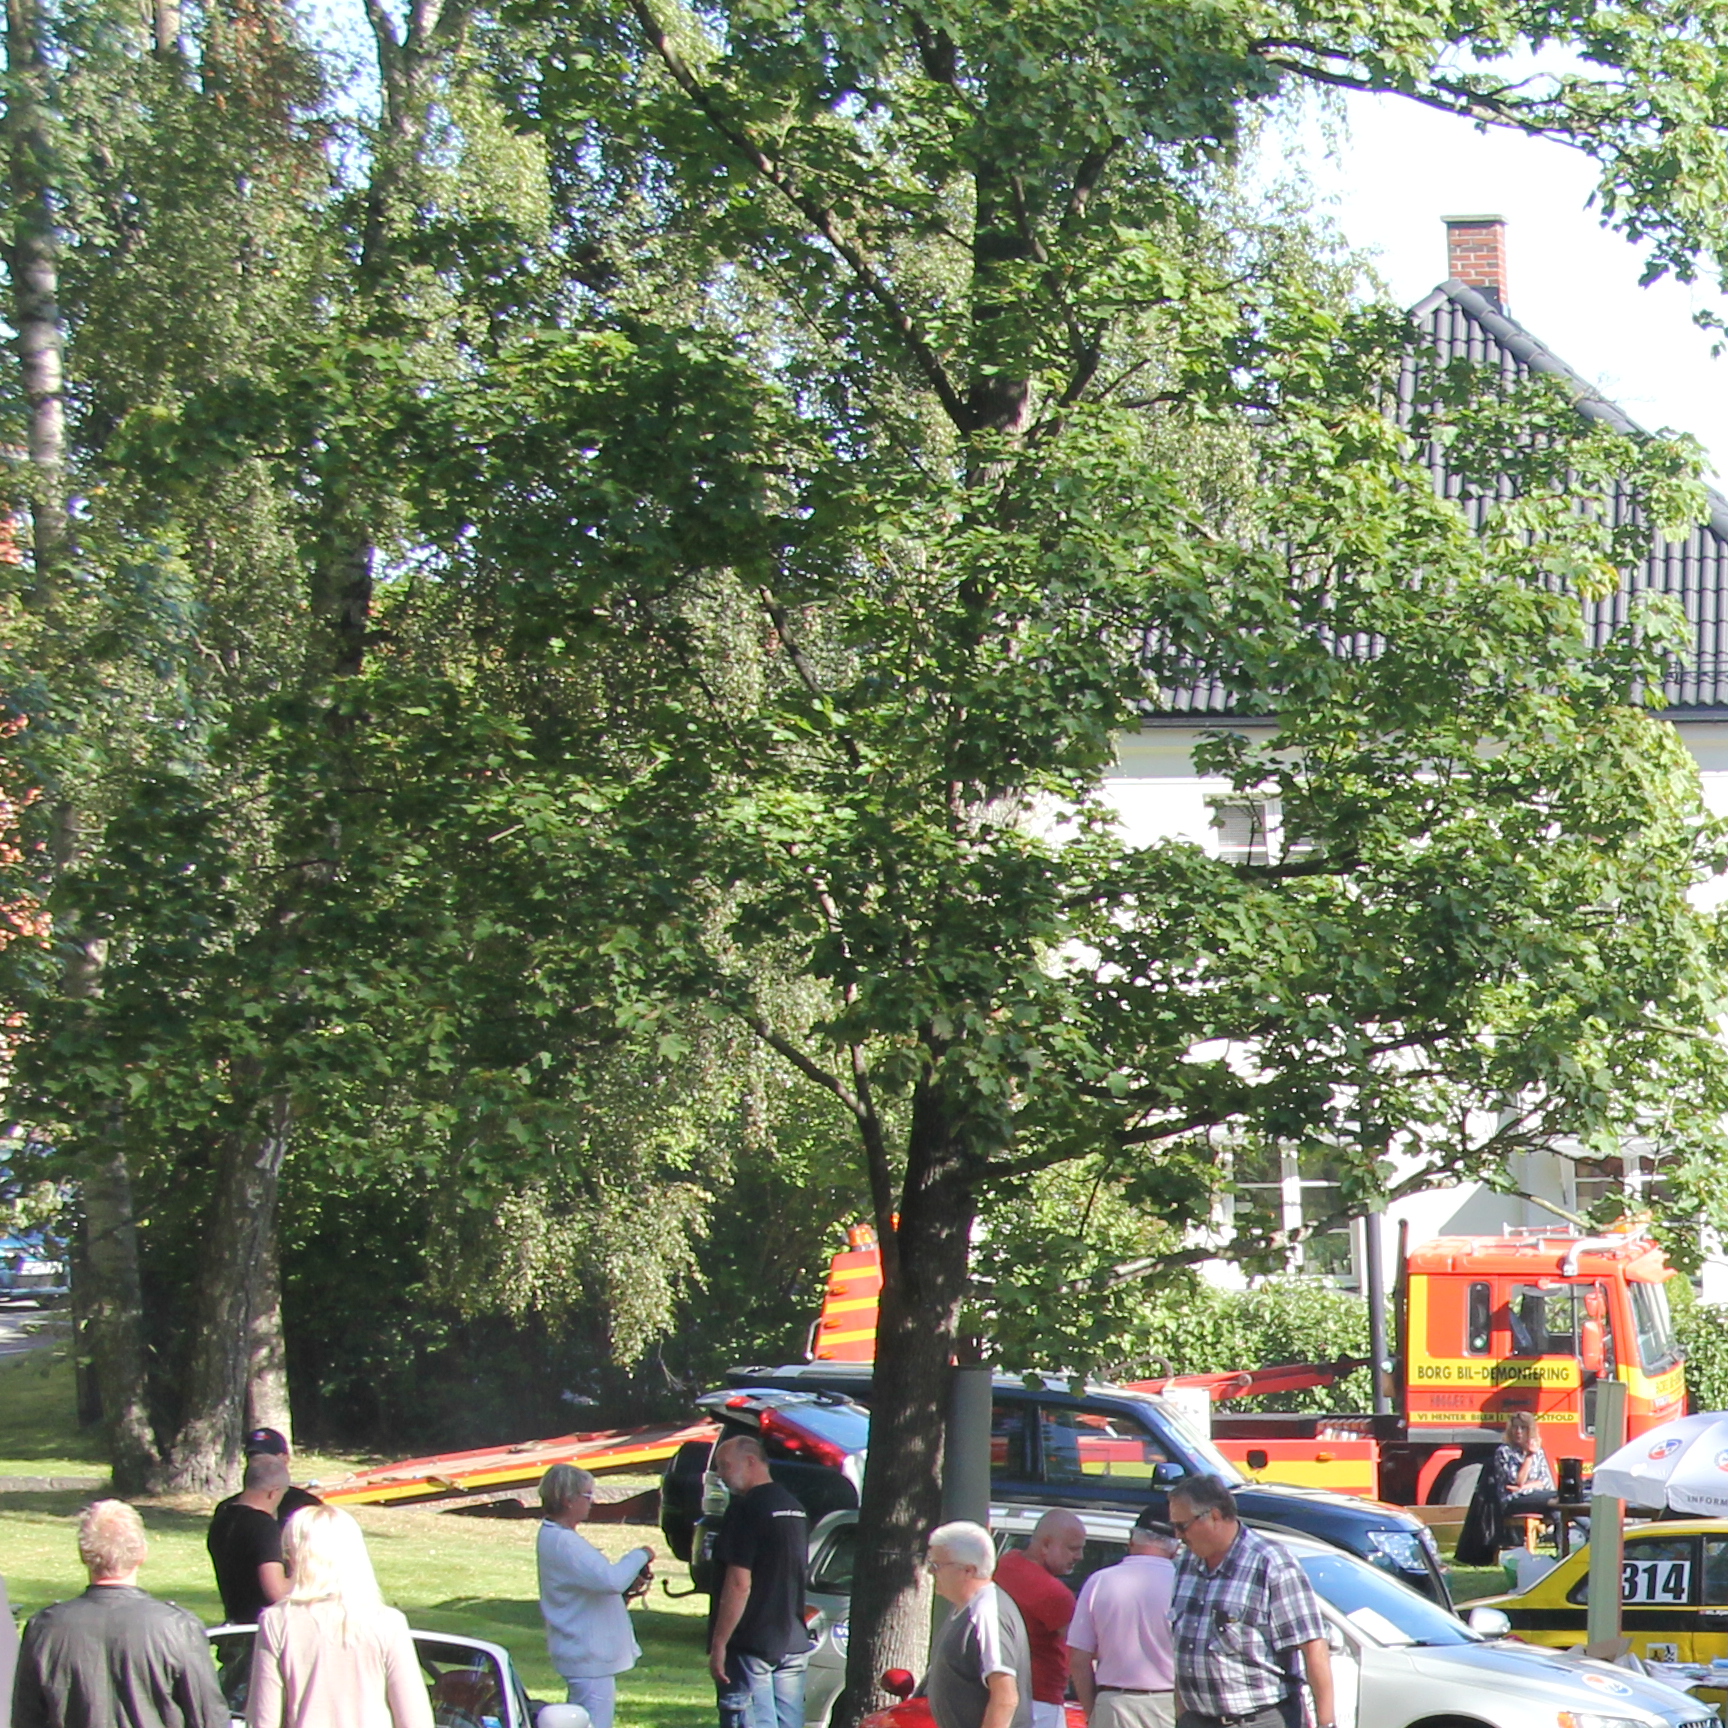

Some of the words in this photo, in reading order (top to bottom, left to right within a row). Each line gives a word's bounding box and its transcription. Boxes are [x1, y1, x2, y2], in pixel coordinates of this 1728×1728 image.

[1417, 1365, 1452, 1380] BORG
[1457, 1365, 1570, 1382] BIL-DEMONTERING
[1417, 1412, 1428, 1421] VI
[1431, 1412, 1466, 1421] HENTER
[1622, 1563, 1685, 1601] 314
